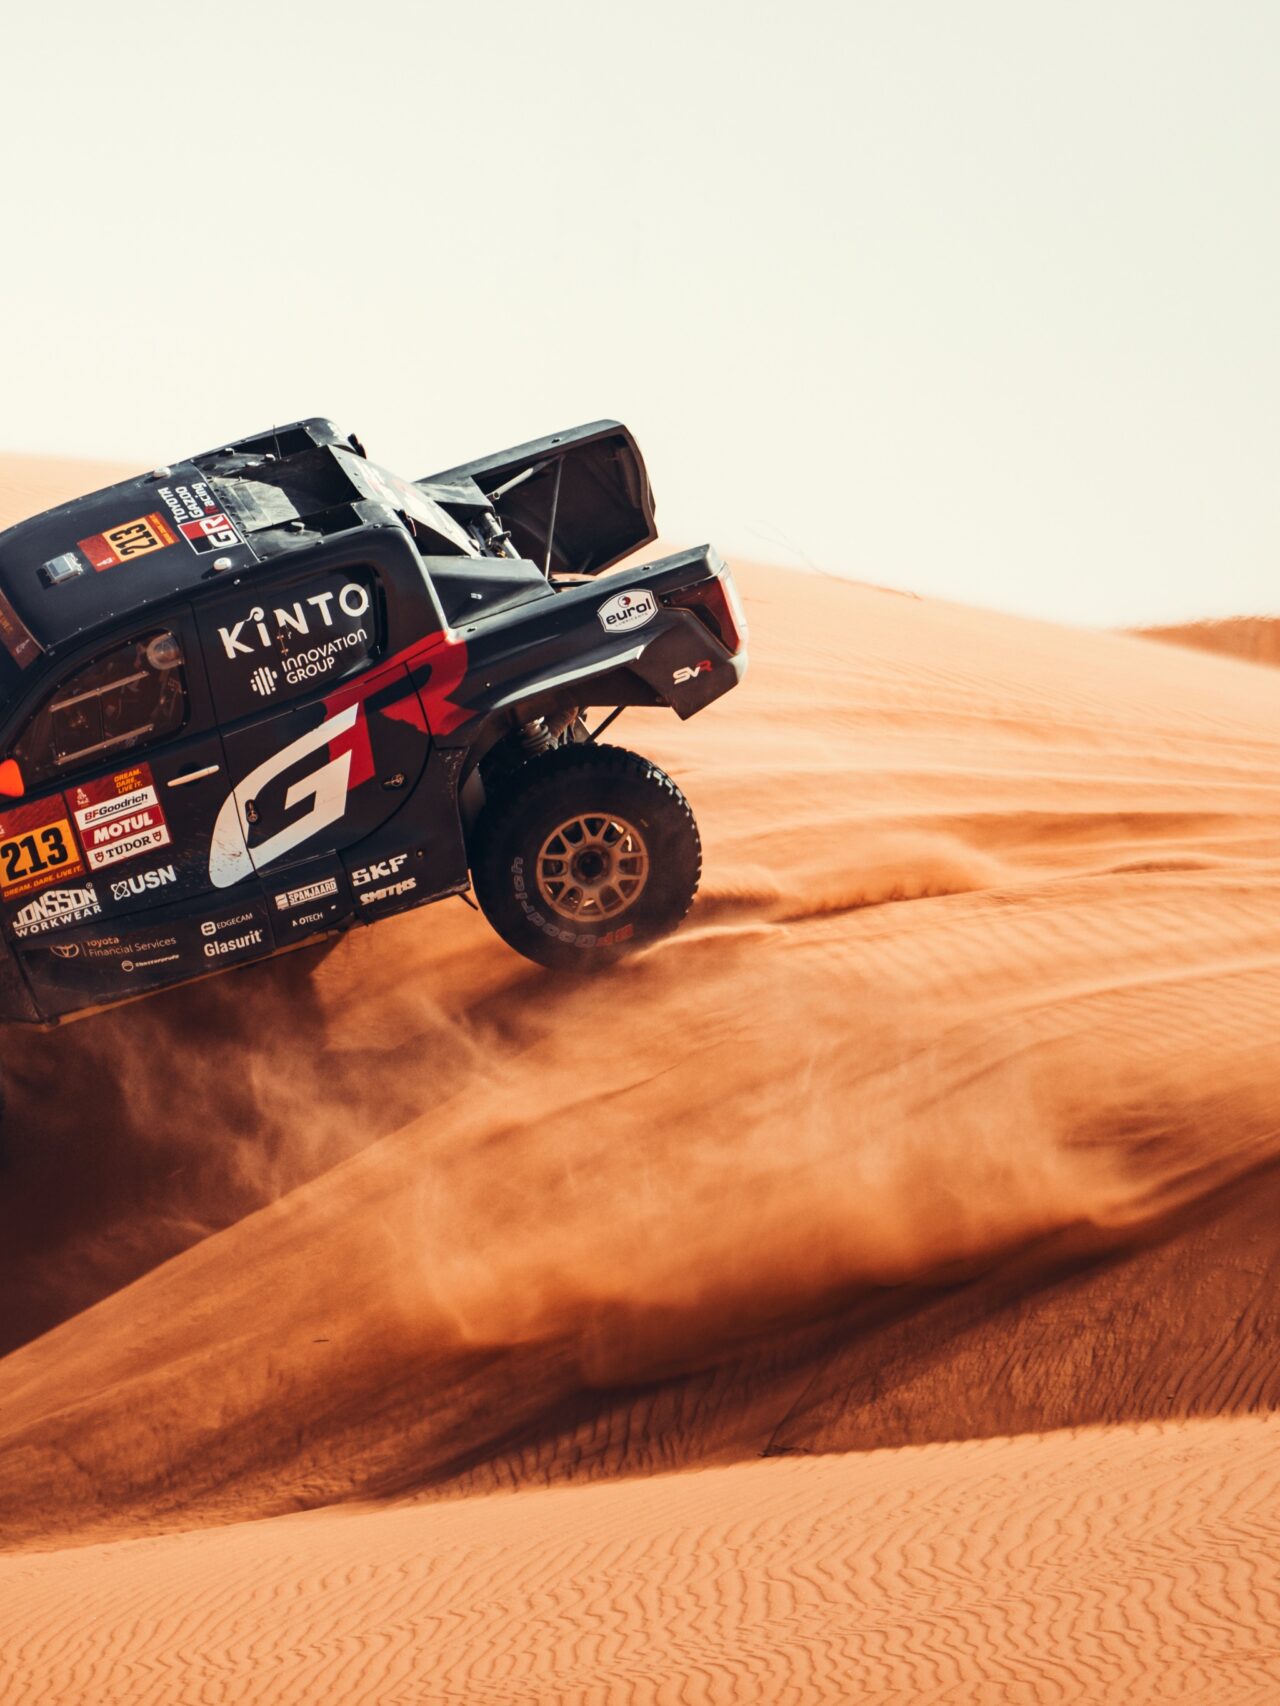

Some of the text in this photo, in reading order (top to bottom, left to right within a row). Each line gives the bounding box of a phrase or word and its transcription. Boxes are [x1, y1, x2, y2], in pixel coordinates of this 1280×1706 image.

[157, 487, 189, 523] TOYOTA
[175, 486, 205, 518] GAZOO
[110, 523, 158, 556] 213
[199, 513, 239, 548] GR
[606, 598, 651, 625] eurol
[286, 656, 335, 684] GROUP
[84, 793, 148, 821] BFGoodrich
[94, 812, 153, 844] MOTUL
[0, 827, 68, 881] 213
[106, 835, 151, 858] TUDOR
[128, 864, 177, 893] USN
[352, 853, 408, 887] SKF
[288, 881, 337, 903] SPANJAARD
[12, 888, 98, 928] JONSSON
[15, 904, 102, 938] WORKWEAR
[216, 912, 253, 930] EDGECAM
[88, 937, 176, 957] Financial Services
[203, 930, 262, 957] Glasurit
